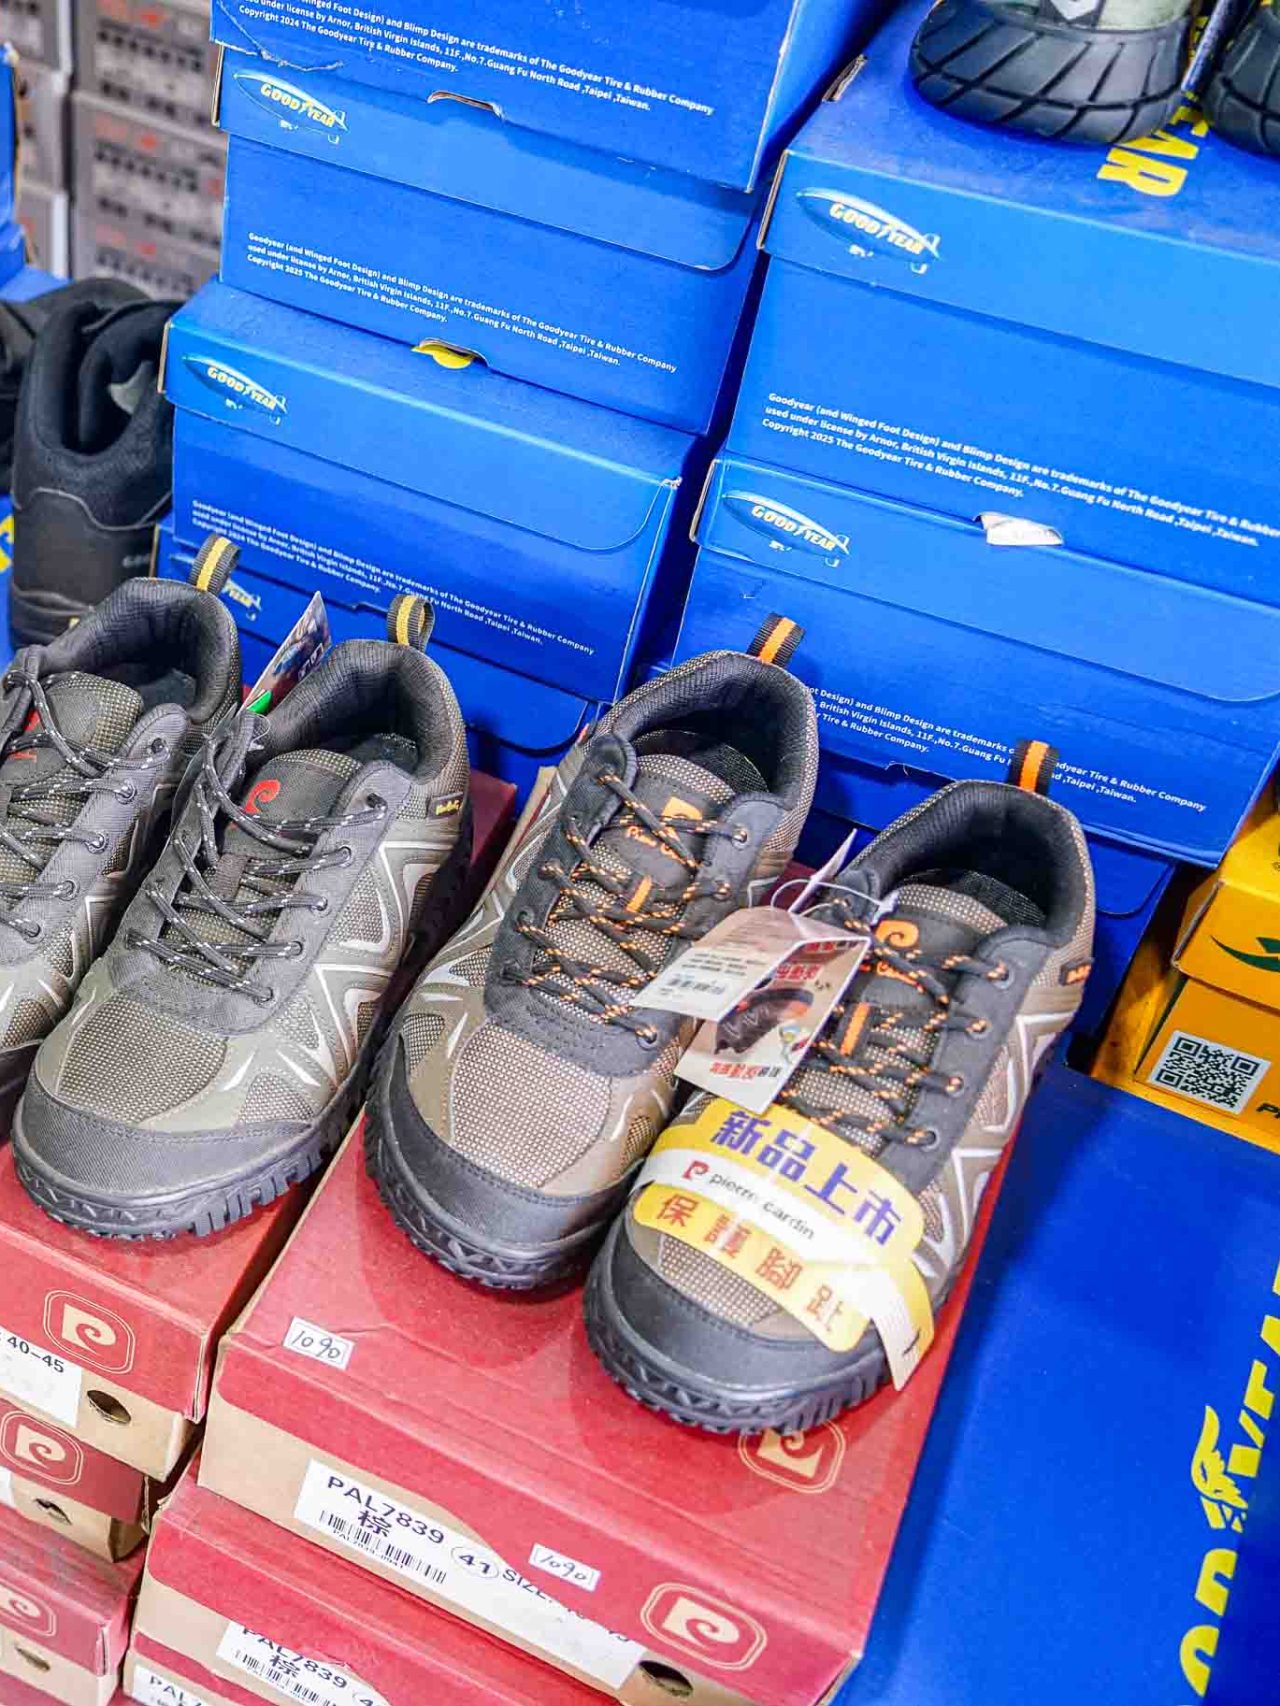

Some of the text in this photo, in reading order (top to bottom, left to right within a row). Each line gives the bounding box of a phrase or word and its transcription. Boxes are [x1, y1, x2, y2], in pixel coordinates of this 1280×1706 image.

[240, 5, 279, 21] Copyright
[279, 16, 299, 27] 2024
[302, 21, 316, 32] The
[318, 26, 357, 42] Goodyear
[359, 37, 375, 51] Tire
[384, 45, 415, 59] Rubber
[417, 53, 457, 72] Company.
[287, 4, 314, 18] license
[327, 15, 352, 29] Arnor,
[355, 23, 381, 36] British
[384, 30, 408, 43] Virgin
[410, 38, 442, 54] Islands,
[530, 70, 556, 84] North
[557, 78, 580, 91] Road
[333, 3, 351, 14] Foot
[354, 9, 385, 24] Design)
[386, 19, 402, 28] and
[404, 22, 428, 36] Blimp
[431, 29, 459, 44] Design
[461, 39, 474, 48] are
[477, 43, 527, 62] trademarks
[541, 59, 557, 70] The
[559, 65, 602, 82] Goodyear
[605, 77, 622, 88] Tire
[633, 85, 666, 100] Rubber
[669, 95, 713, 115] Company
[248, 254, 283, 270] Copyright
[305, 271, 318, 280] The
[320, 276, 355, 292] Goodyear
[357, 287, 371, 297] Tire
[381, 295, 408, 308] Rubber
[410, 305, 447, 322] Company.
[763, 419, 809, 437] Copyright
[810, 432, 834, 443] 2025
[836, 438, 854, 449] The
[855, 444, 902, 462] Goodyear
[905, 457, 923, 468] Tire
[934, 466, 972, 482] Rubber
[973, 477, 1023, 497] Company.
[766, 407, 789, 418] used
[790, 414, 818, 425] under
[820, 420, 853, 436] license
[869, 434, 899, 449] Arnor,
[901, 443, 935, 458] British
[937, 452, 966, 466] Virgin
[968, 461, 1007, 479] Islands,
[1112, 500, 1144, 515] North
[1145, 509, 1173, 523] Road
[769, 393, 814, 411] Goodyear
[816, 406, 838, 418] (and
[839, 411, 877, 428] Winged
[878, 422, 900, 434] Foot
[902, 429, 939, 446] Design)
[941, 441, 961, 452] and
[962, 444, 992, 460] Blimp
[994, 454, 1030, 470] Design
[1031, 466, 1048, 475] are
[1049, 470, 1112, 492] trademarks
[1127, 488, 1148, 502] The
[1149, 496, 1202, 516] Goodyear
[1206, 510, 1228, 525] Tire
[751, 504, 837, 552] GOODYEAR
[820, 702, 849, 715] British
[852, 711, 877, 724] Virgin
[880, 720, 913, 736] Islands,
[820, 690, 855, 707] Design)
[856, 702, 873, 712] and
[874, 707, 901, 720] Blimp
[903, 715, 934, 729] Design
[936, 726, 951, 735] are
[953, 731, 1006, 751] trademarks
[1053, 757, 1087, 775] dyear
[1090, 771, 1108, 782] Tire
[1120, 780, 1156, 795] Rubber
[1157, 792, 1205, 812] Company
[823, 713, 840, 725] Tire
[850, 722, 883, 737] Rubber
[885, 734, 928, 752] Company.
[709, 1109, 902, 1247] 新品上市
[709, 1173, 815, 1240] pierr cardin
[327, 1475, 446, 1545] PAL7839
[459, 1551, 493, 1577] 41
